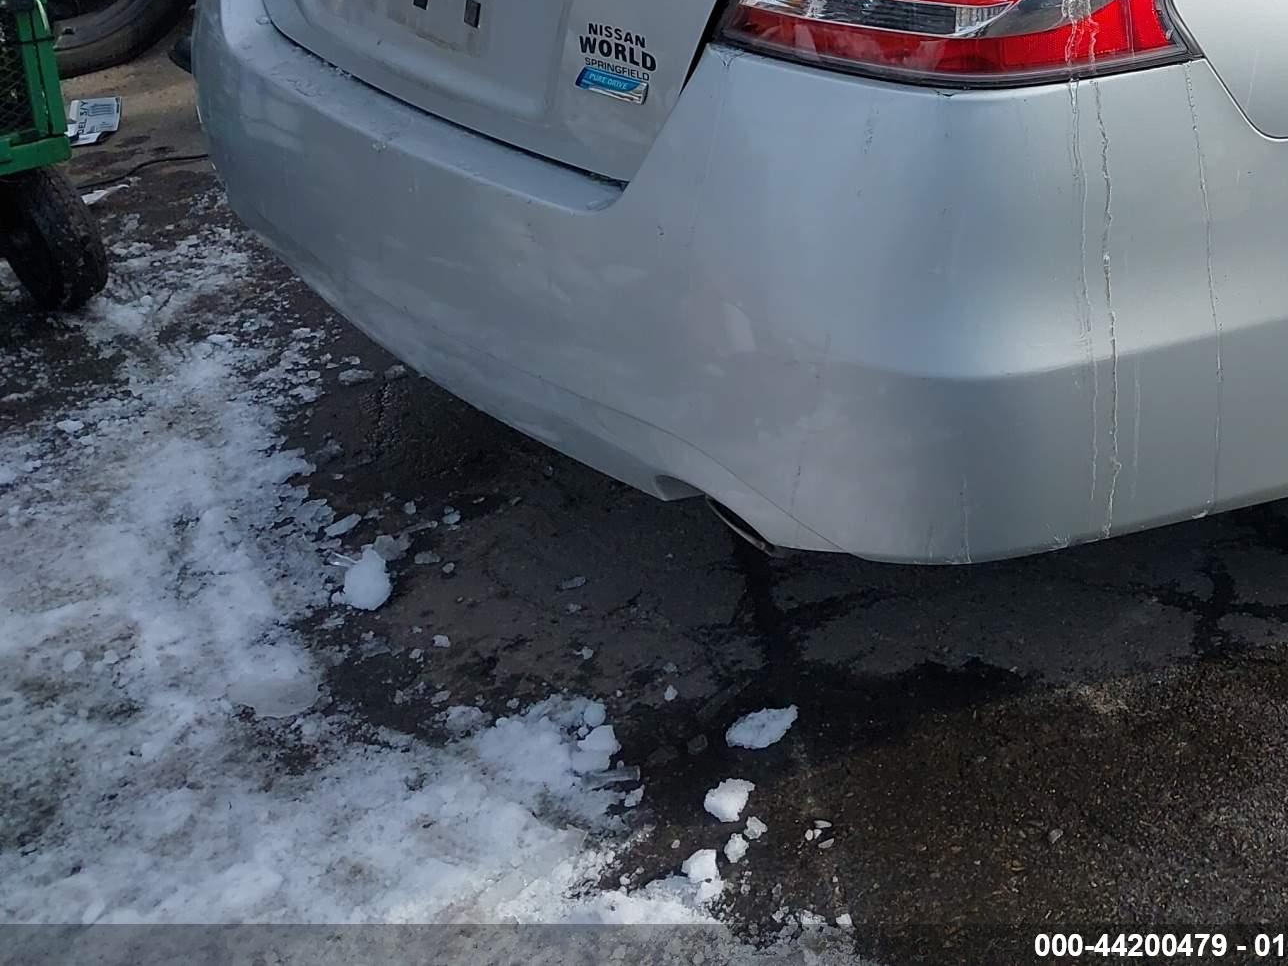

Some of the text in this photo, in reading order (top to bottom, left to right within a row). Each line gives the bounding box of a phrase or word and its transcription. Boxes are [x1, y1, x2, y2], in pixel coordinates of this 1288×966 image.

[588, 22, 646, 48] NISSAN
[579, 35, 657, 72] WORLD
[584, 56, 650, 81] SPRINGFIELD
